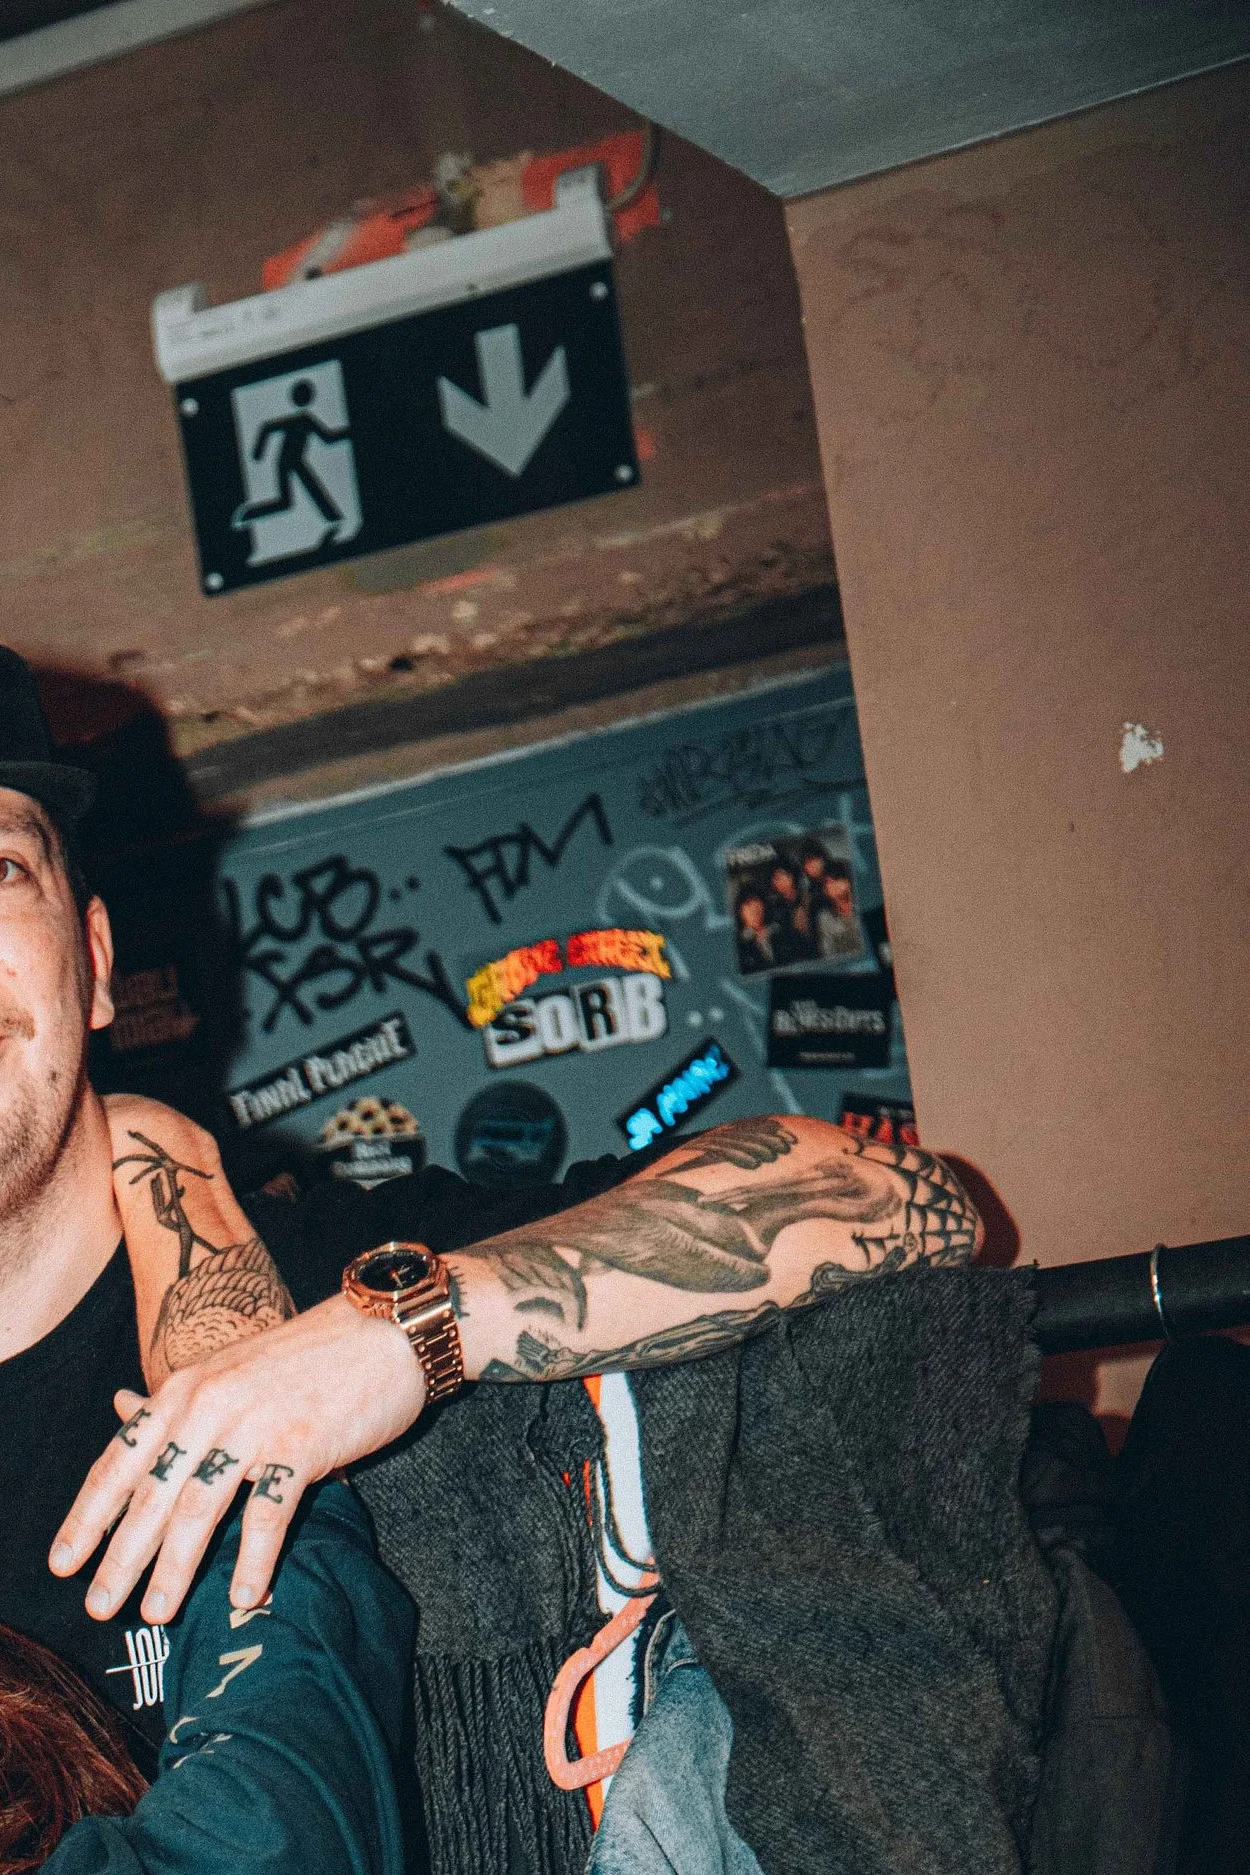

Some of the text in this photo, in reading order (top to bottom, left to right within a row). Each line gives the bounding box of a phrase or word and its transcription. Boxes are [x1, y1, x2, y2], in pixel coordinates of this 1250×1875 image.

[486, 972, 667, 1068] SORB
[230, 1017, 410, 1128] FINAL PLAGUE
